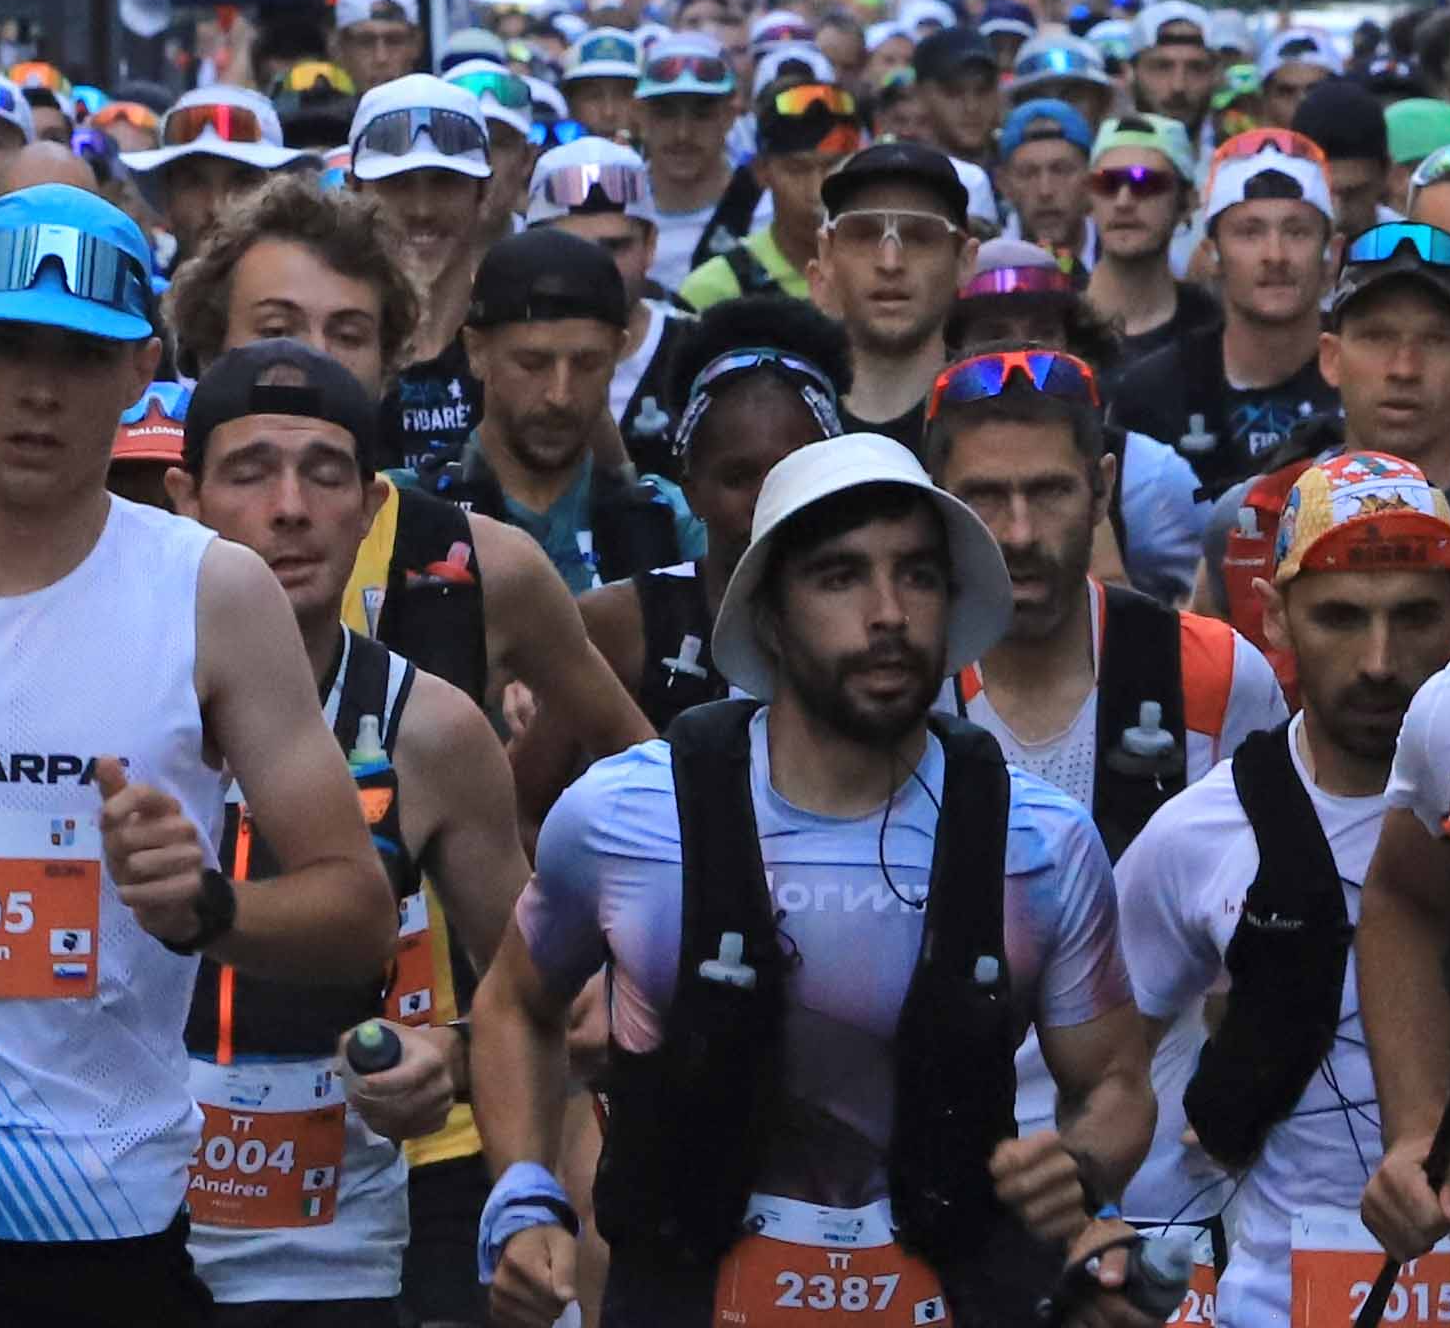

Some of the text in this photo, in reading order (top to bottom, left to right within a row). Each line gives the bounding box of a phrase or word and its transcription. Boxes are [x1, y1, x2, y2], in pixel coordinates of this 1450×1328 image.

[230, 1114, 254, 1133] TT
[190, 1174, 269, 1198] Andrea
[826, 1251, 853, 1270] TT
[774, 1270, 902, 1312] 2387
